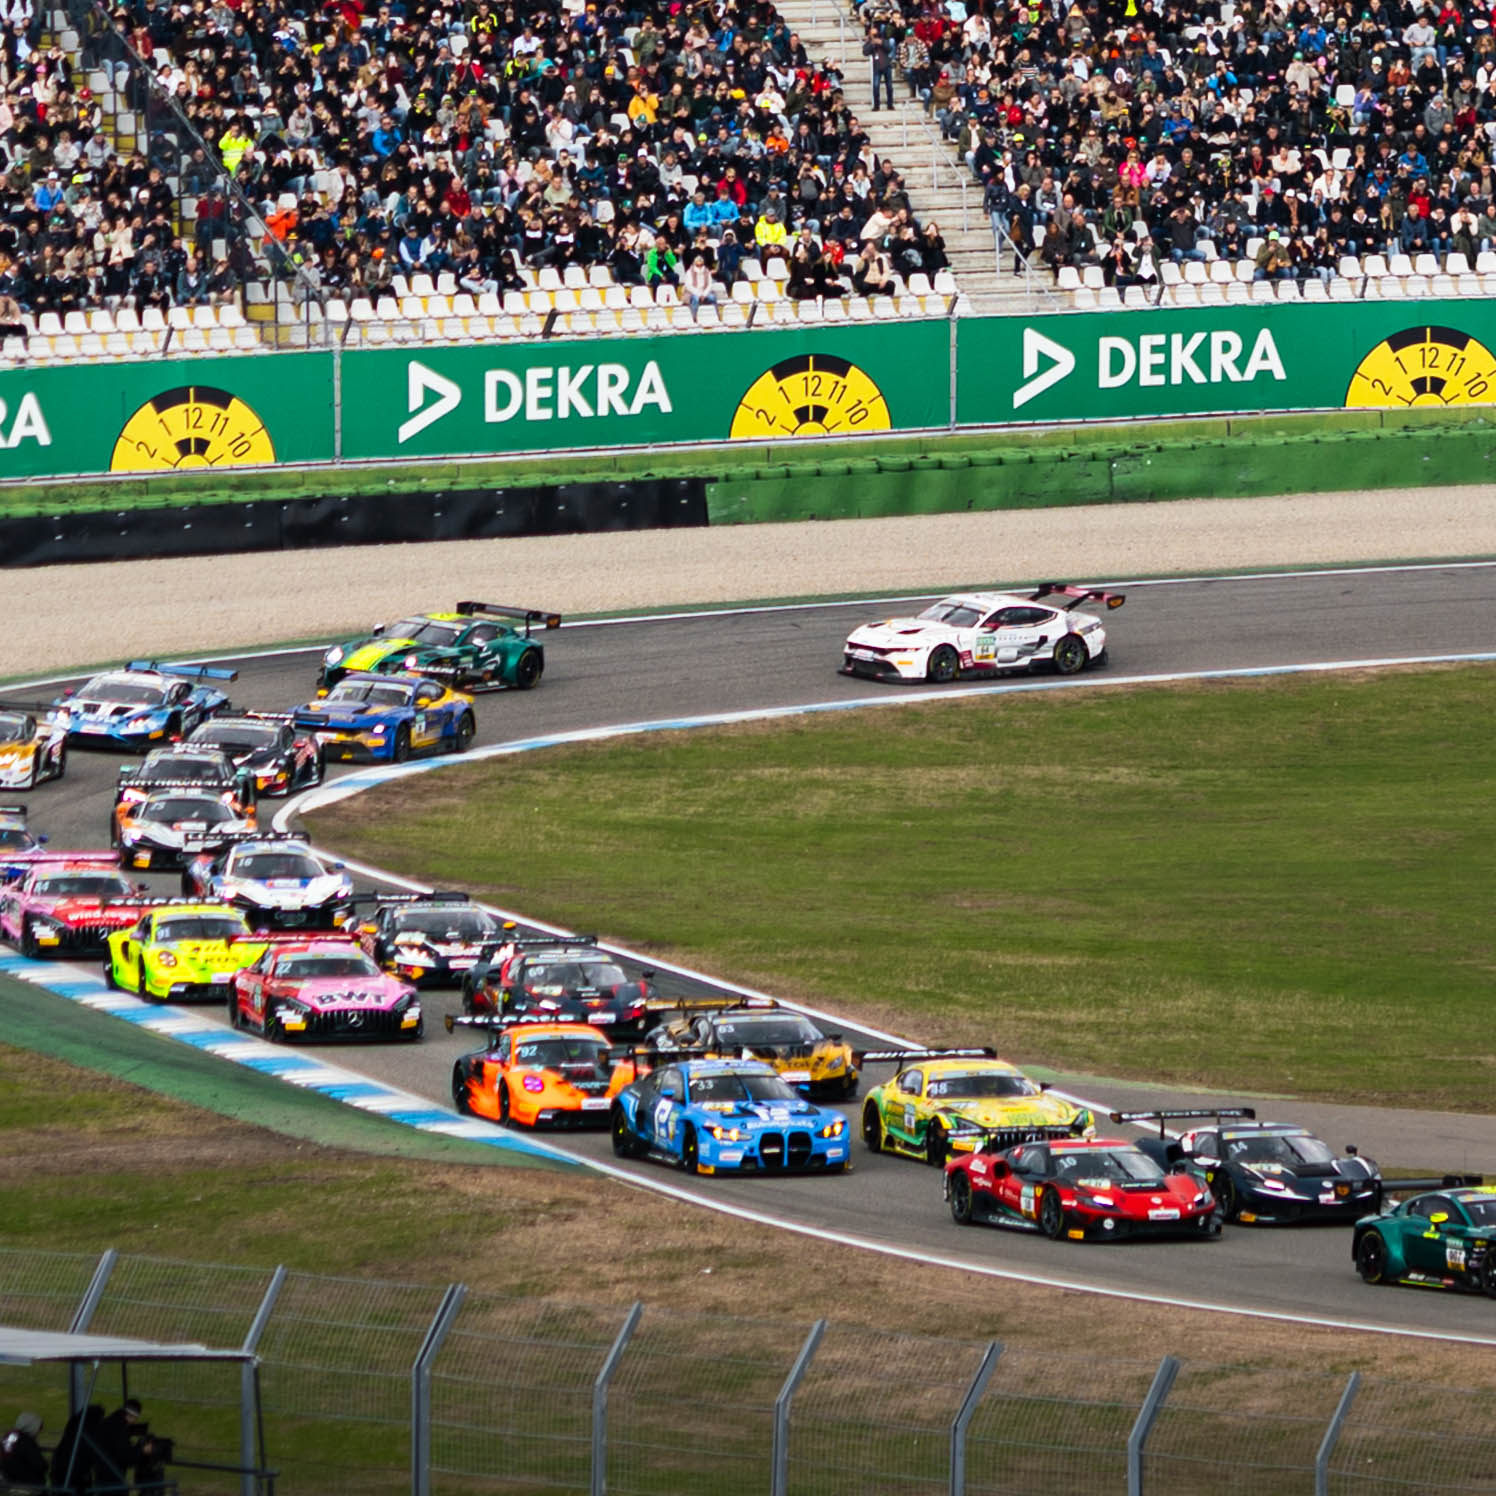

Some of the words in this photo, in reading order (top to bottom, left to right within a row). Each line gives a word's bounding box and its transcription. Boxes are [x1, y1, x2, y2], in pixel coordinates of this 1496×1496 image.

[1099, 329, 1286, 388] DEKRA
[1371, 378, 1393, 396] 2
[1394, 355, 1409, 374] 1
[1419, 347, 1439, 368] 12
[1446, 352, 1466, 374] 11
[1464, 372, 1489, 398] 10
[485, 361, 672, 423] DEKRA
[756, 409, 777, 426] 2
[778, 386, 792, 404] 1
[802, 375, 821, 397] 12
[831, 380, 847, 404] 11
[844, 399, 869, 425] 10
[136, 441, 157, 459] 2
[158, 418, 173, 437] 1
[183, 407, 202, 429] 12
[211, 412, 230, 435] 11
[227, 432, 252, 458] 10
[316, 991, 385, 1007] BWT
